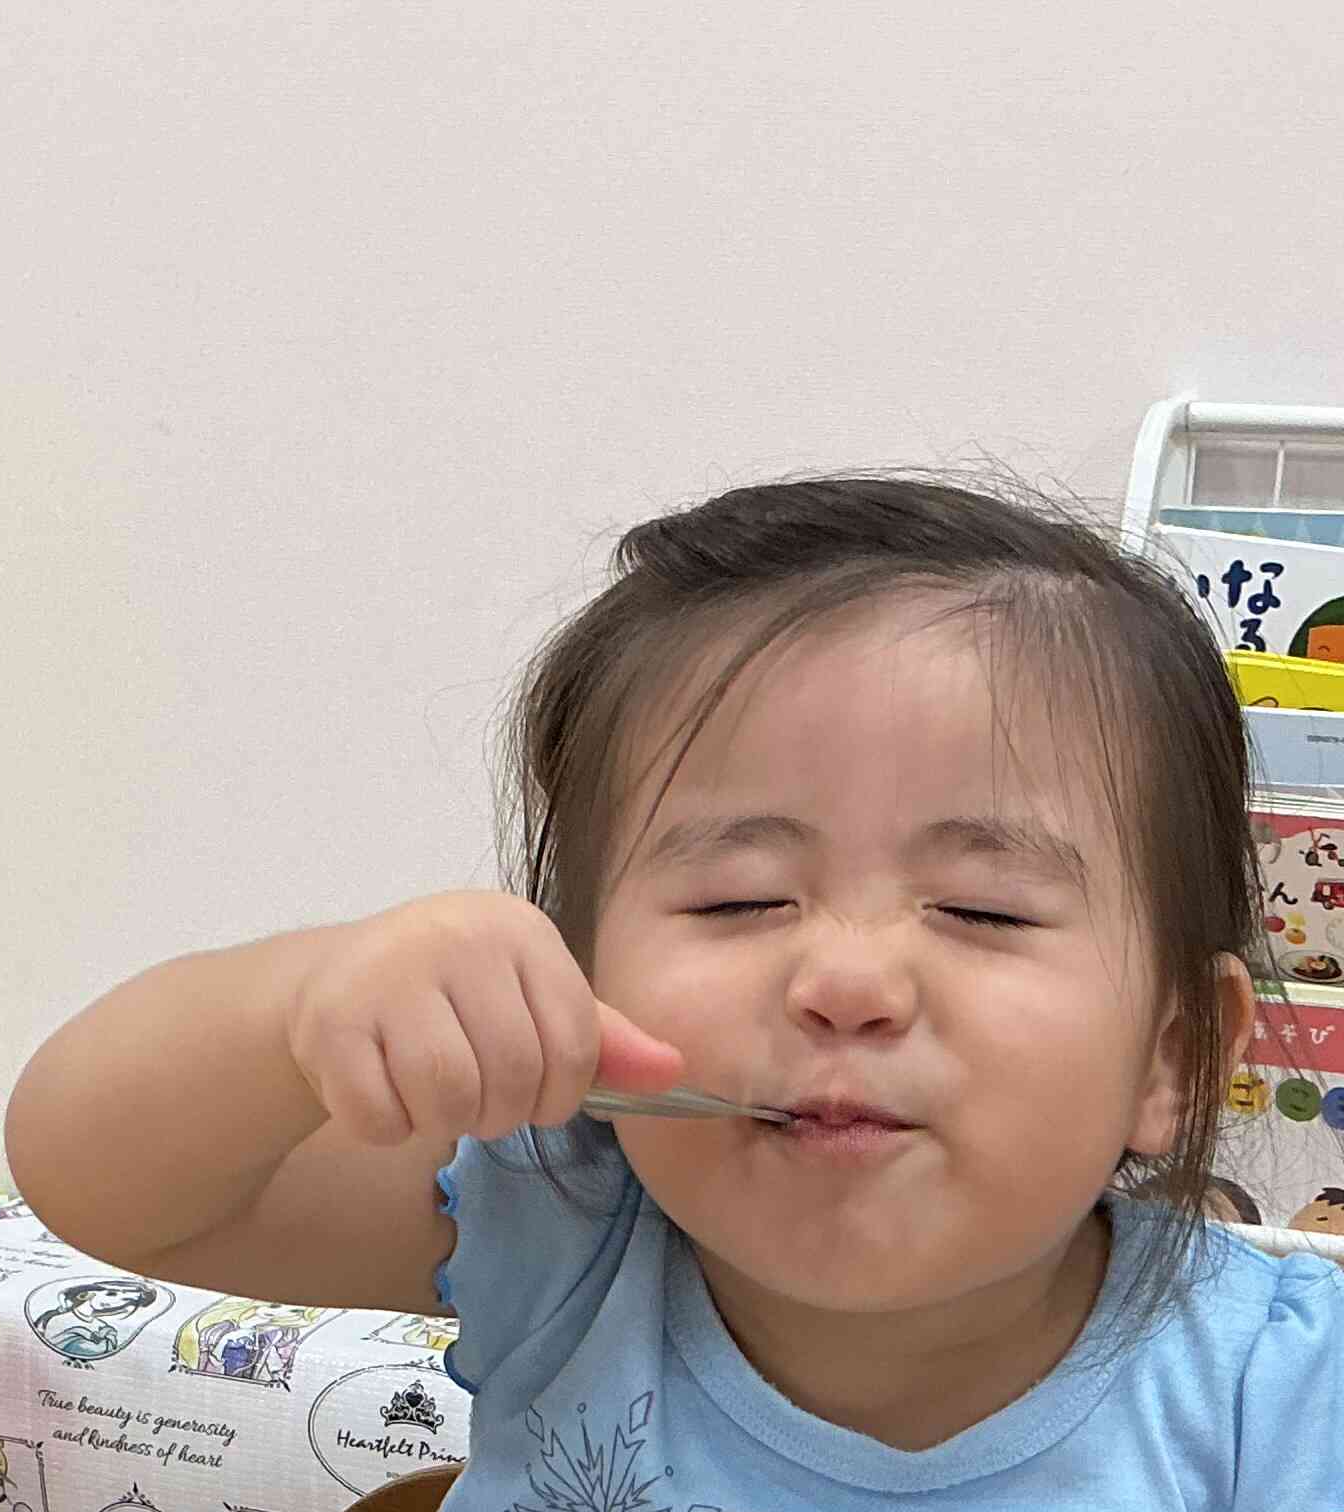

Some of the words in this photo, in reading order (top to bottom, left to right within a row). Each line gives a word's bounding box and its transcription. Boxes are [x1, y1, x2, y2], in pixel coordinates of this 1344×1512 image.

[37, 1389, 74, 1412] True
[78, 1396, 132, 1429] beauty
[136, 1410, 152, 1424] is
[152, 1415, 238, 1447] generosity
[52, 1427, 89, 1446] and
[88, 1429, 154, 1458] kindness
[156, 1442, 178, 1466] of
[178, 1444, 224, 1468] heart
[336, 1428, 414, 1458] Heartfelt
